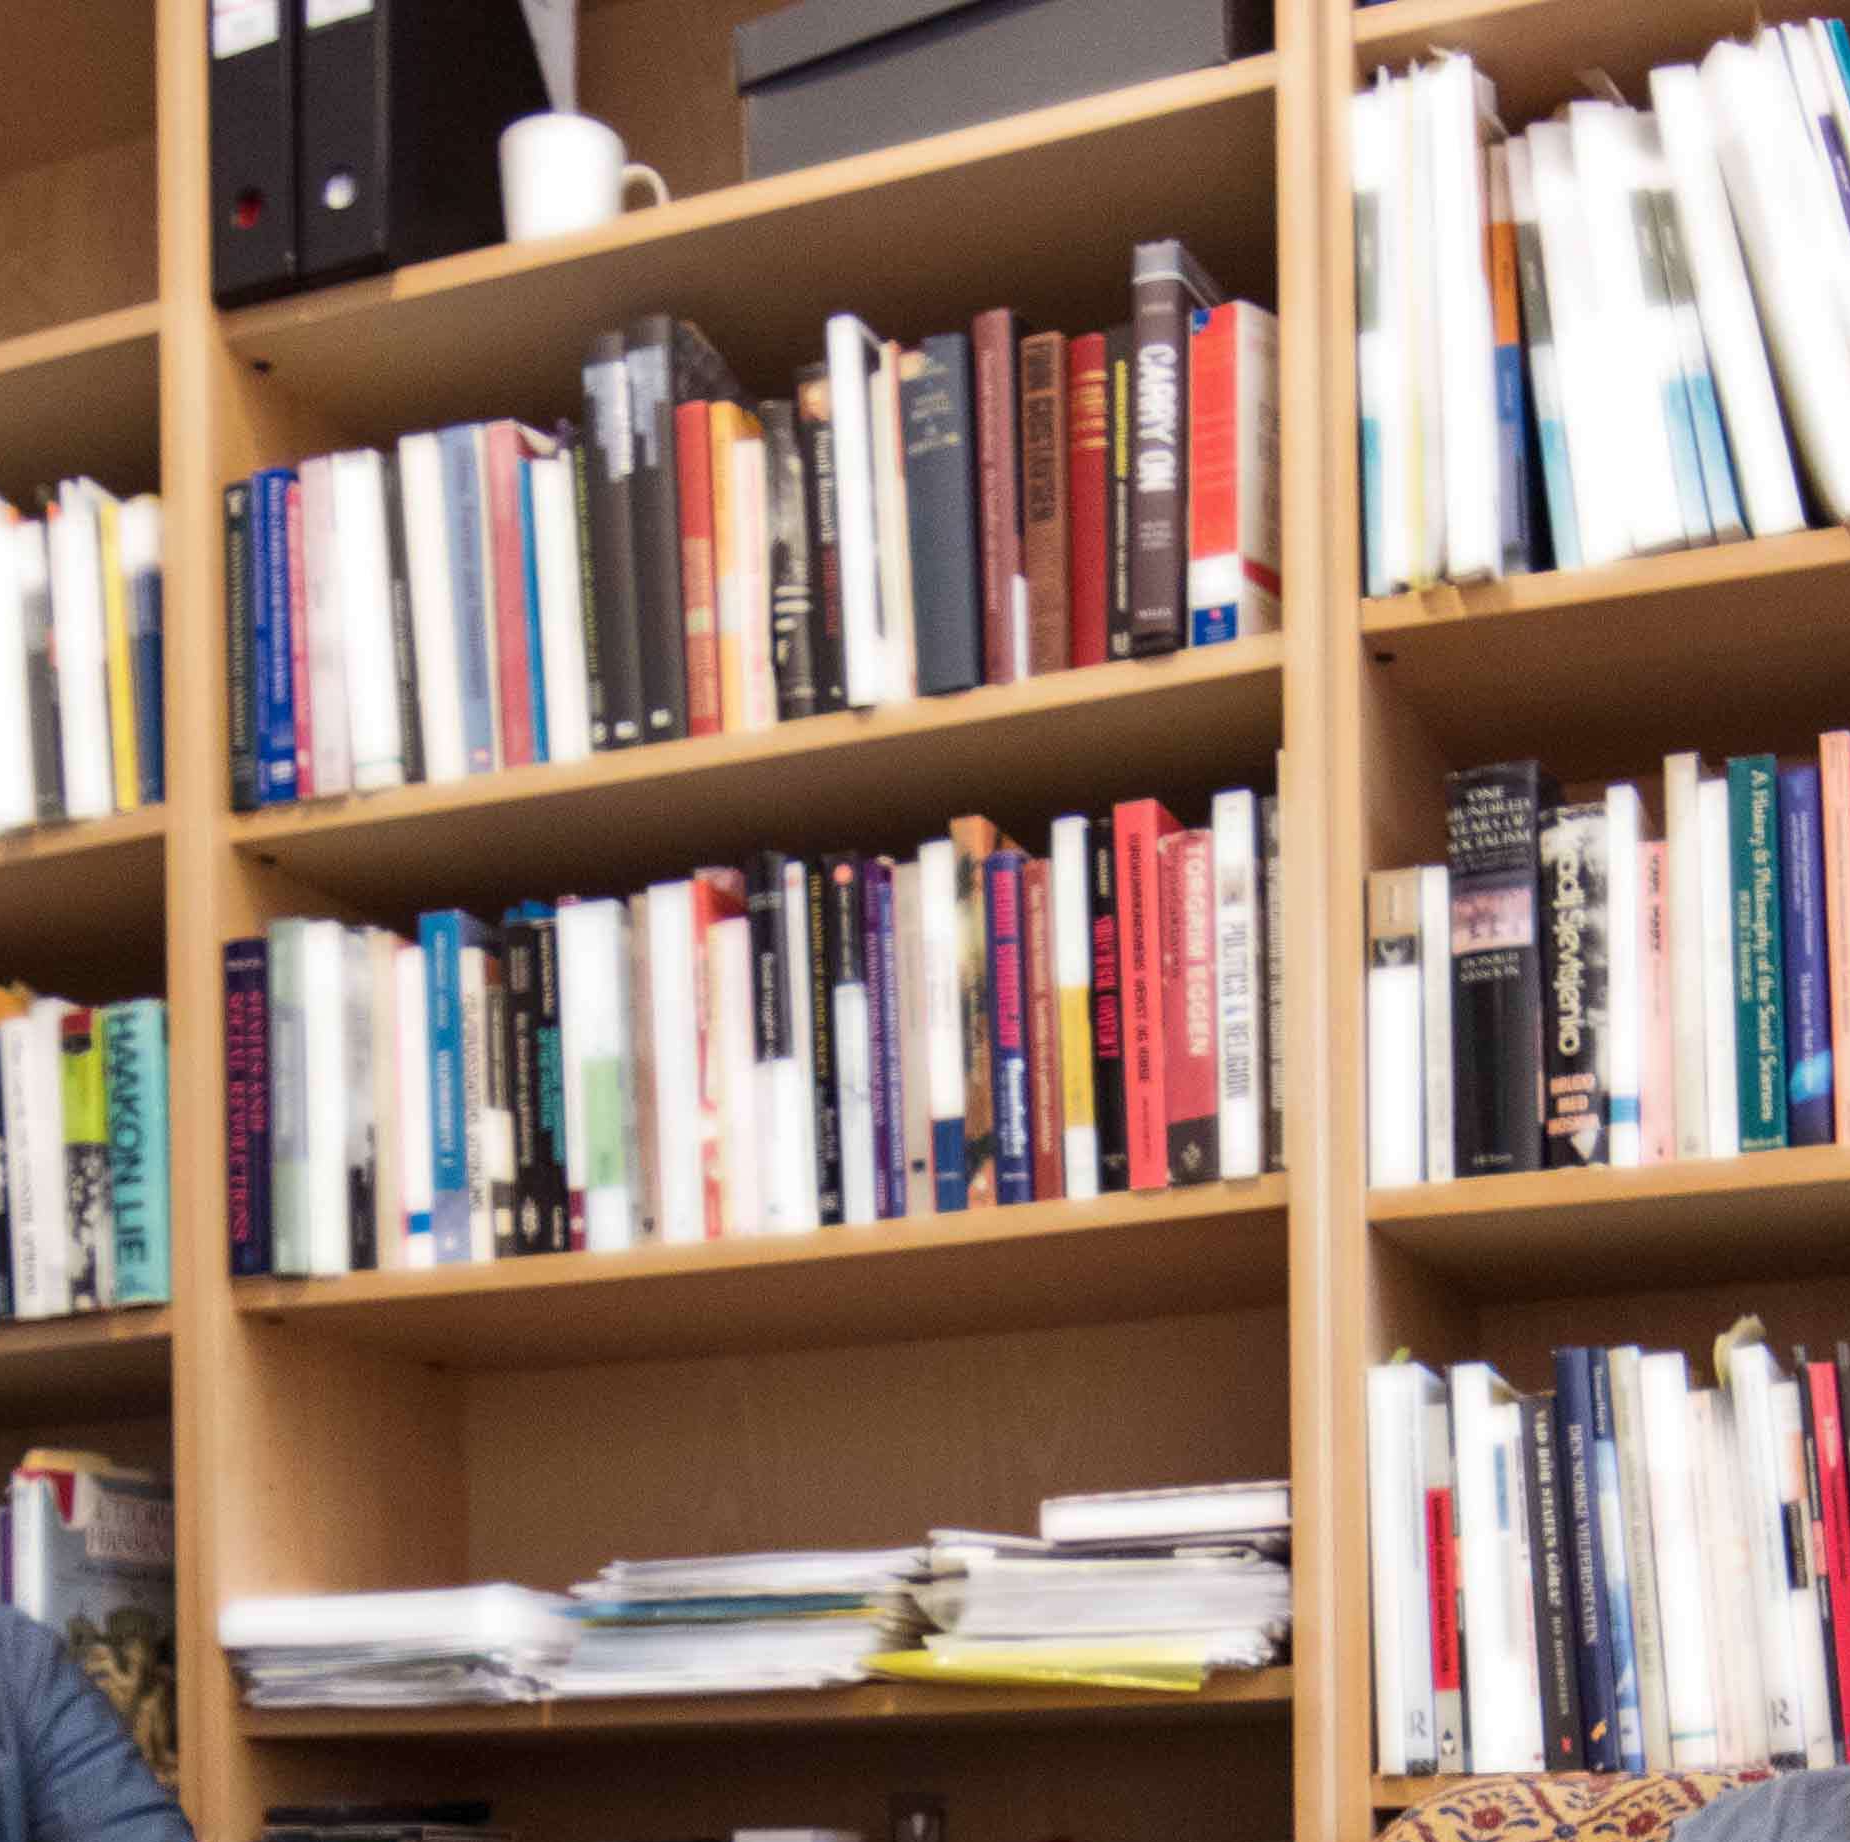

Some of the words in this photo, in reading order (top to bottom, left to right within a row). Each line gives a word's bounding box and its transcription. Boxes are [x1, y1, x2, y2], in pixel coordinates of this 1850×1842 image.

[1137, 343, 1177, 445] CARRY
[1136, 448, 1178, 494] ON
[1466, 785, 1506, 801] ONE
[1752, 769, 1767, 787] A
[1446, 797, 1532, 820] HUNDRED
[1750, 789, 1769, 844] History
[1446, 829, 1532, 854] SOCIALISM
[1753, 849, 1771, 863] &
[1184, 843, 1207, 960] TORGRIM
[1752, 867, 1773, 953] Philosophy
[1757, 959, 1773, 973] of
[1757, 975, 1774, 1001] the
[1187, 964, 1211, 1058] EGGEN
[1757, 1004, 1775, 1051] Social
[107, 1009, 144, 1185] HAAKON
[1759, 1055, 1777, 1121] Sciences
[116, 1201, 147, 1265] LIE
[1534, 1409, 1549, 1443] VAD
[1568, 1424, 1583, 1457] DEN
[1538, 1448, 1554, 1483] BÖR
[1570, 1460, 1589, 1519] NORSKE
[1540, 1488, 1557, 1549] STATEN
[1545, 1553, 1562, 1607] GÖRA?
